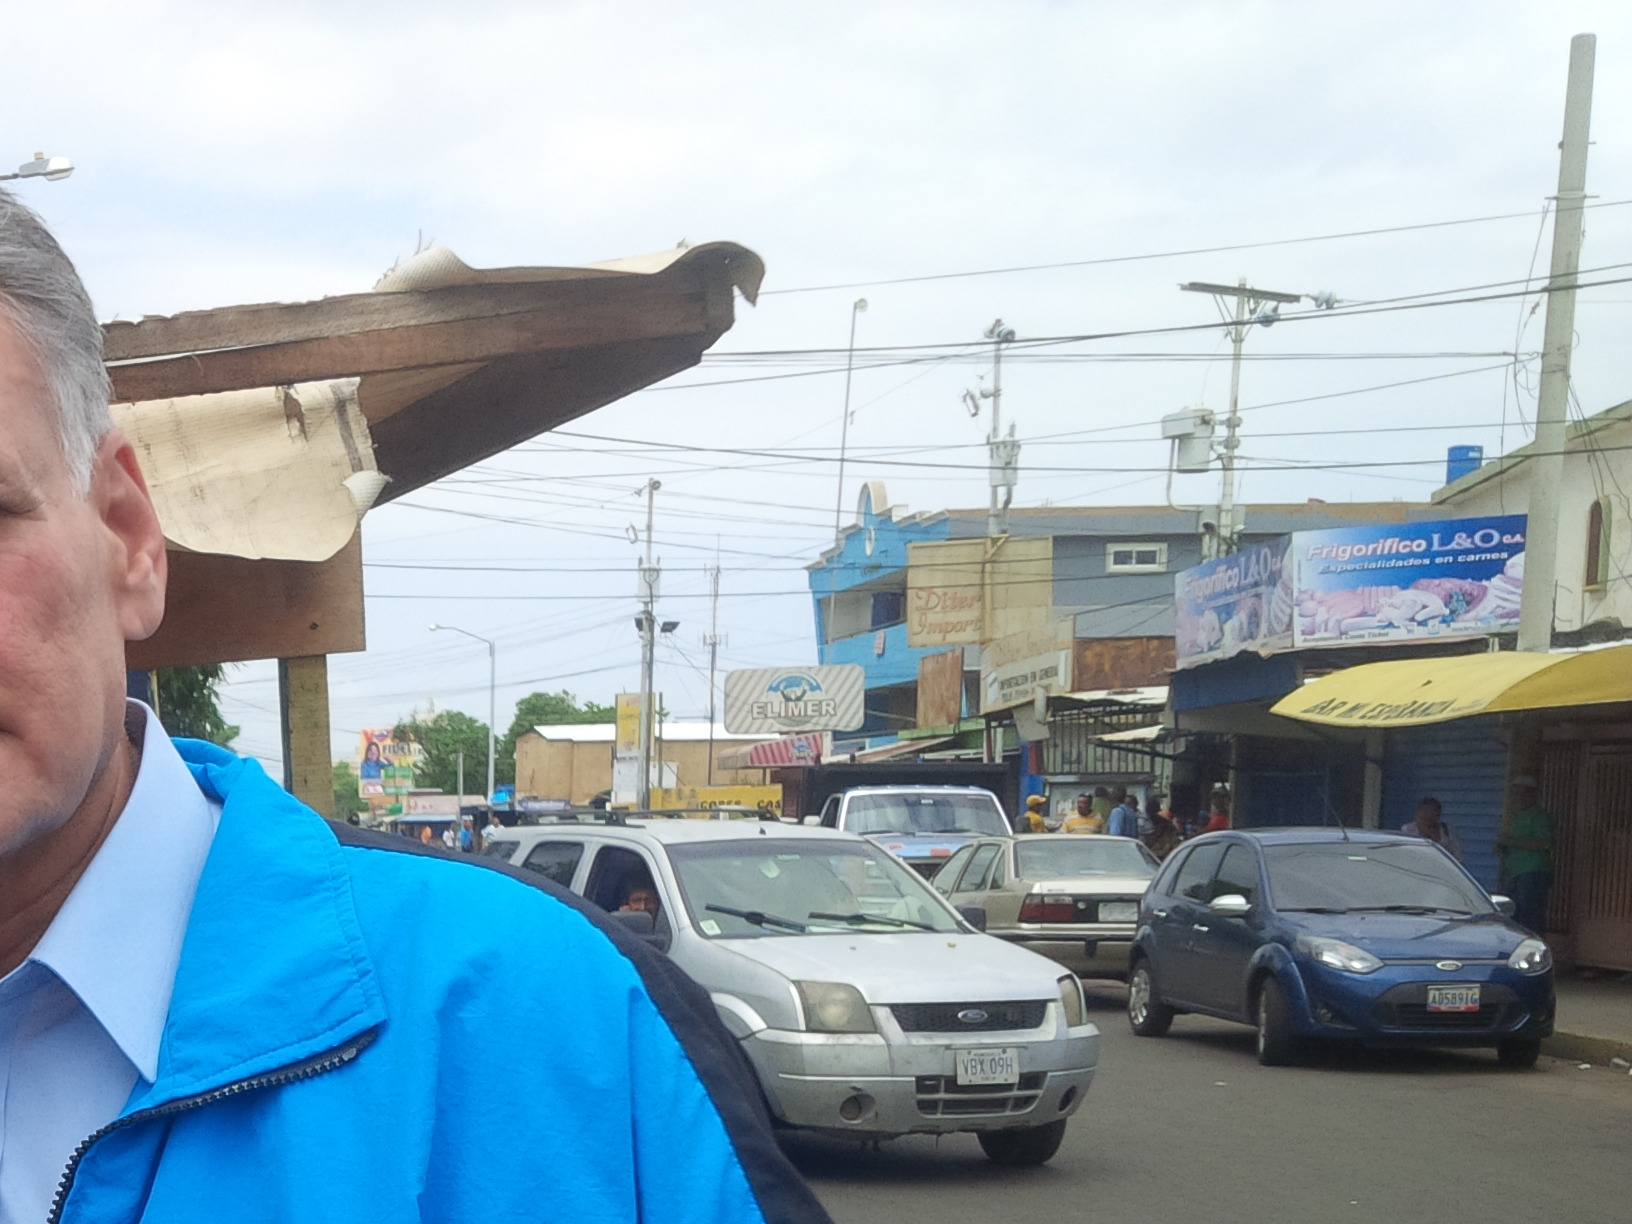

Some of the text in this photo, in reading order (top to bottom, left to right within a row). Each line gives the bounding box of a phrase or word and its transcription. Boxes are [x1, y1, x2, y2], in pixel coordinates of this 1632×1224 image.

[1431, 528, 1501, 551] L&O
[1317, 551, 1509, 575] Especialidades en carnes
[751, 699, 837, 720] ELIMER
[962, 1057, 1013, 1076] VBX 09H
